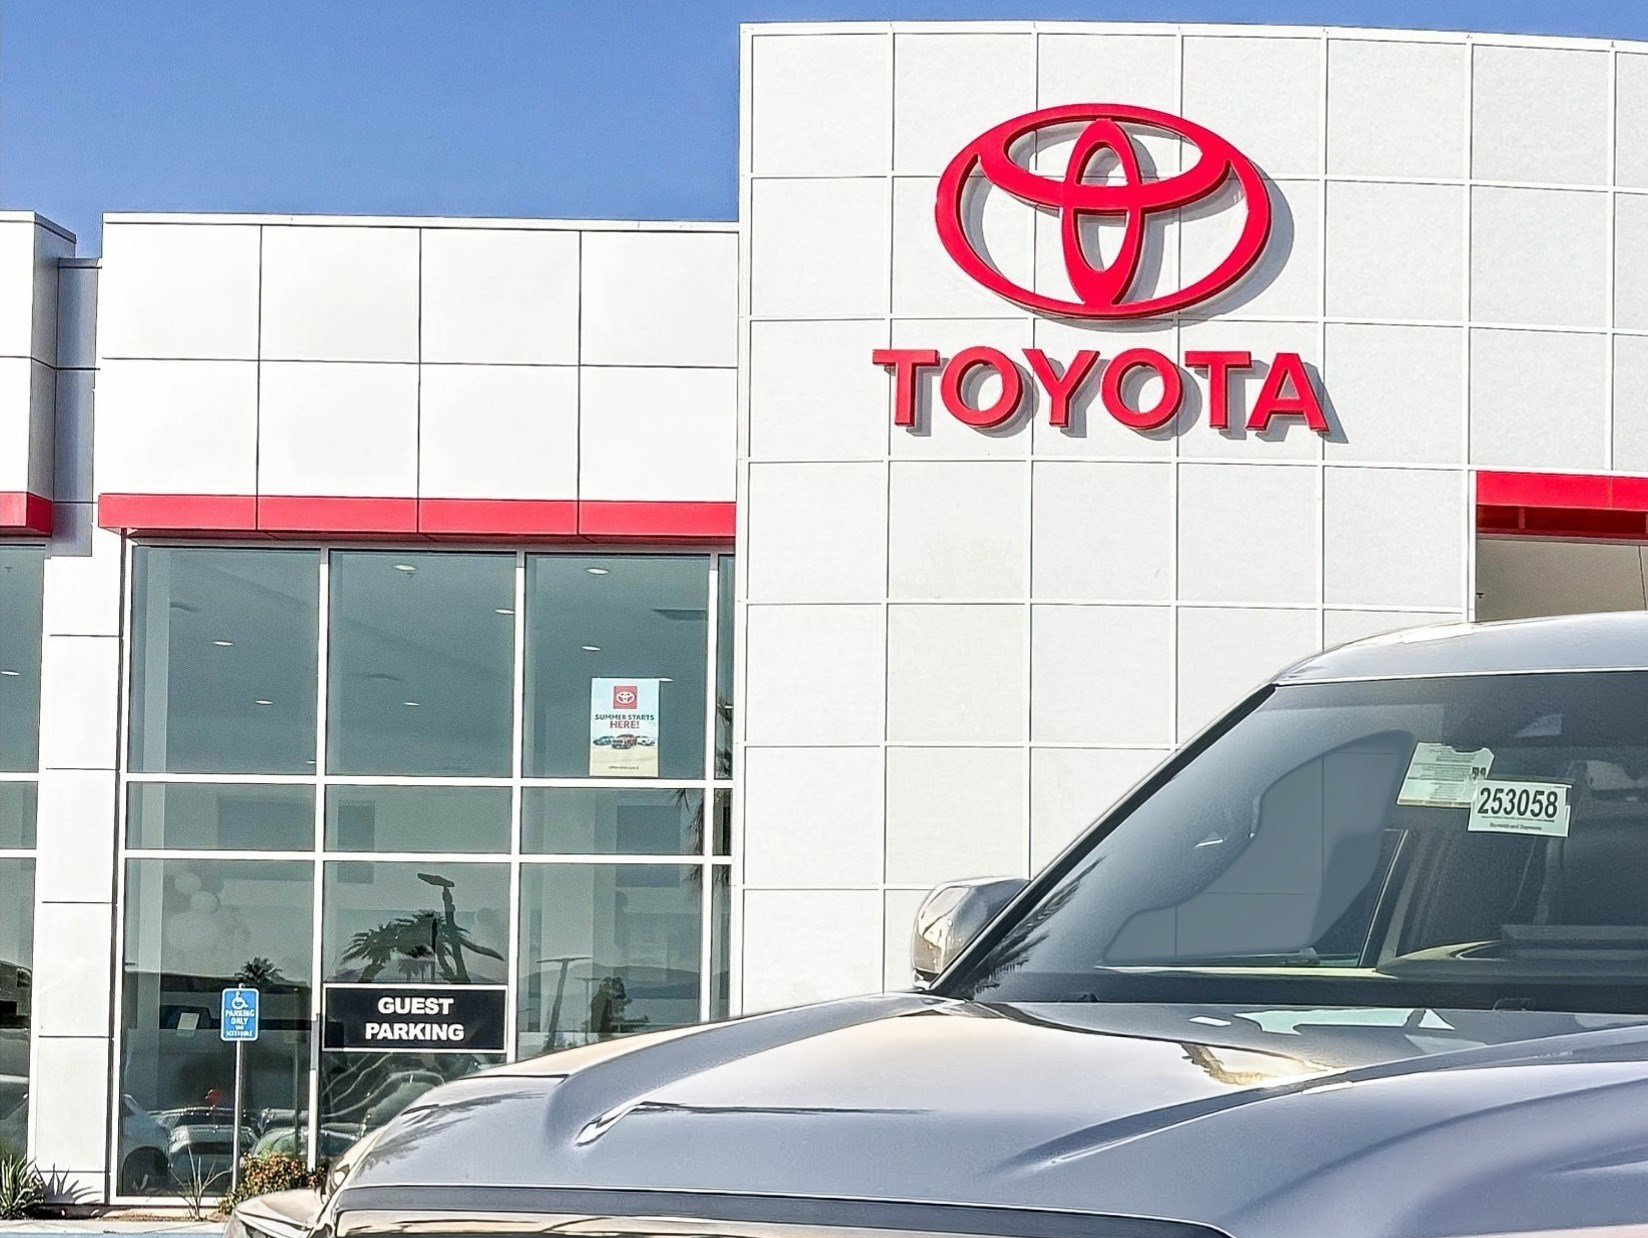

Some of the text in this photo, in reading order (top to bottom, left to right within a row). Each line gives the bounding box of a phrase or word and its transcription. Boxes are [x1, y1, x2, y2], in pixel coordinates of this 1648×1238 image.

[873, 346, 1330, 434] TOYOTA
[609, 720, 640, 729] HERE!
[1477, 787, 1559, 818] 253058
[225, 1009, 255, 1017] PARKING
[378, 997, 454, 1015] GUEST
[365, 1022, 465, 1041] PARKING
